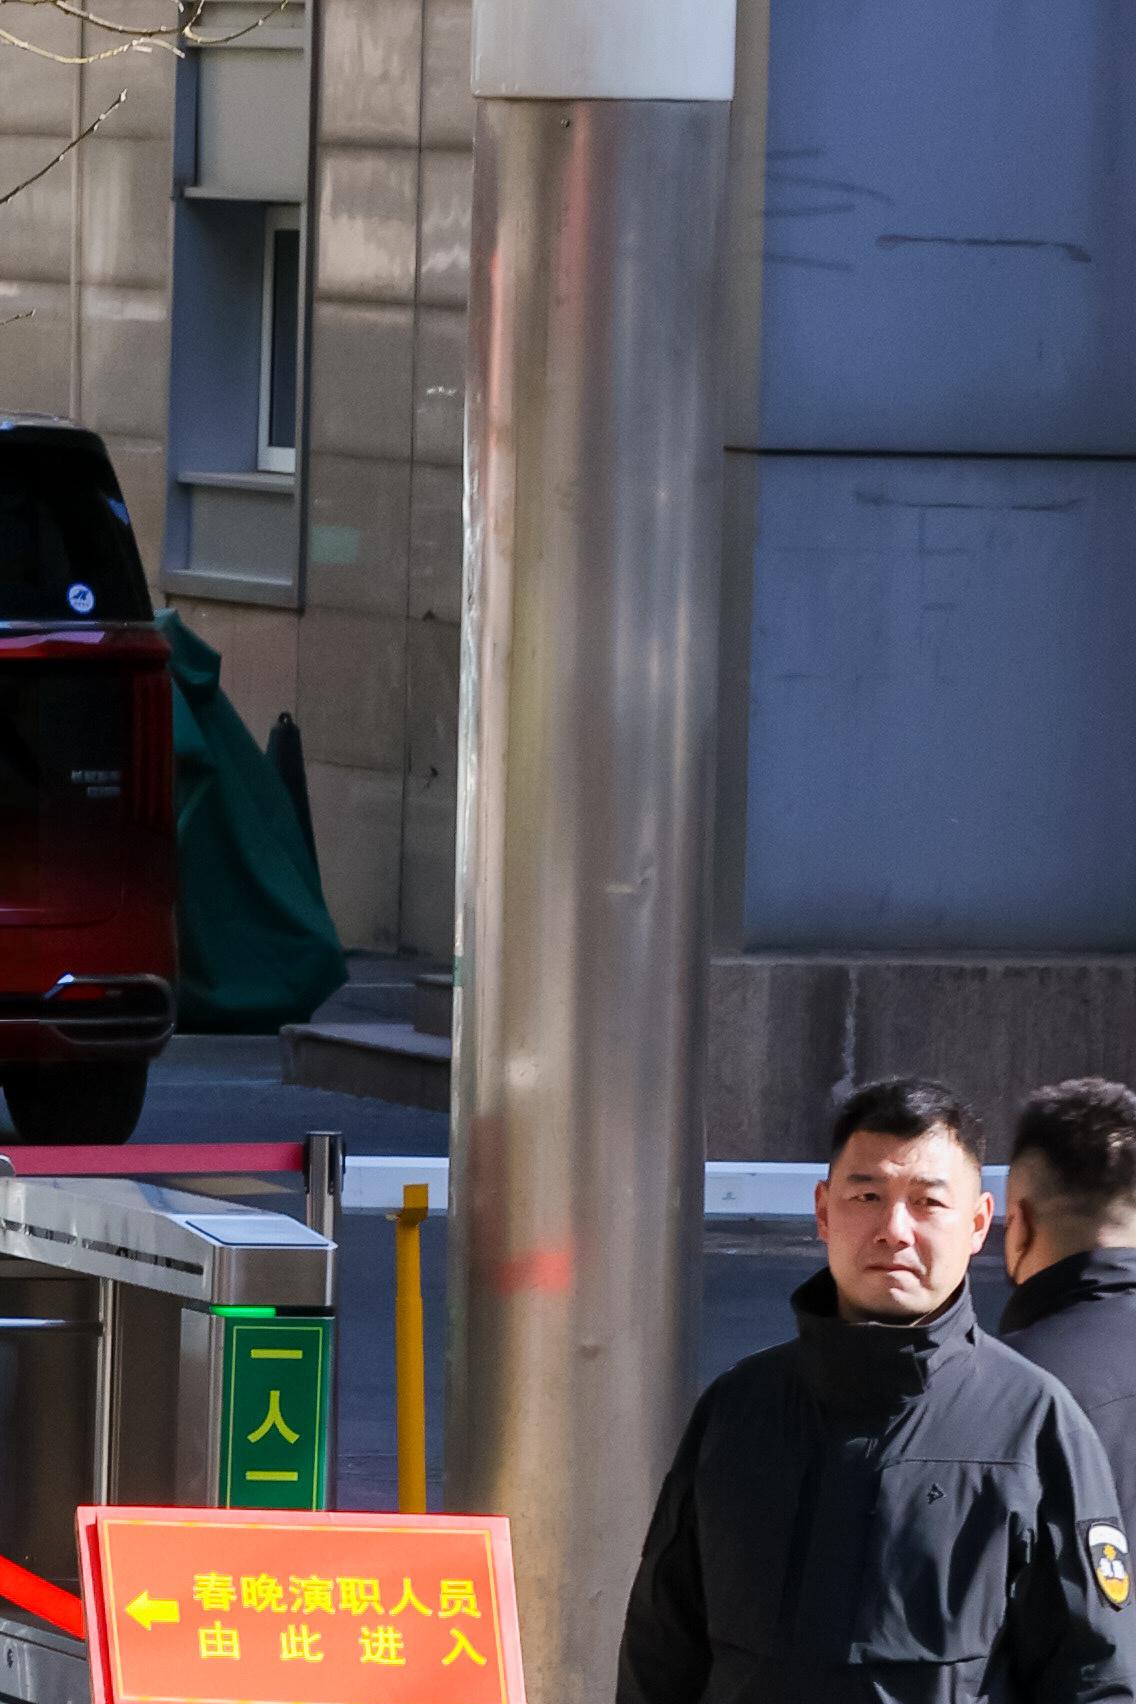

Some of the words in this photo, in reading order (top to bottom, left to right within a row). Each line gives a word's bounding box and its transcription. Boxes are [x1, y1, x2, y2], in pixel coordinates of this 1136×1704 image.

[193, 1572, 482, 1620] 春晚演职人员
[198, 1626, 488, 1666] 由此进入
